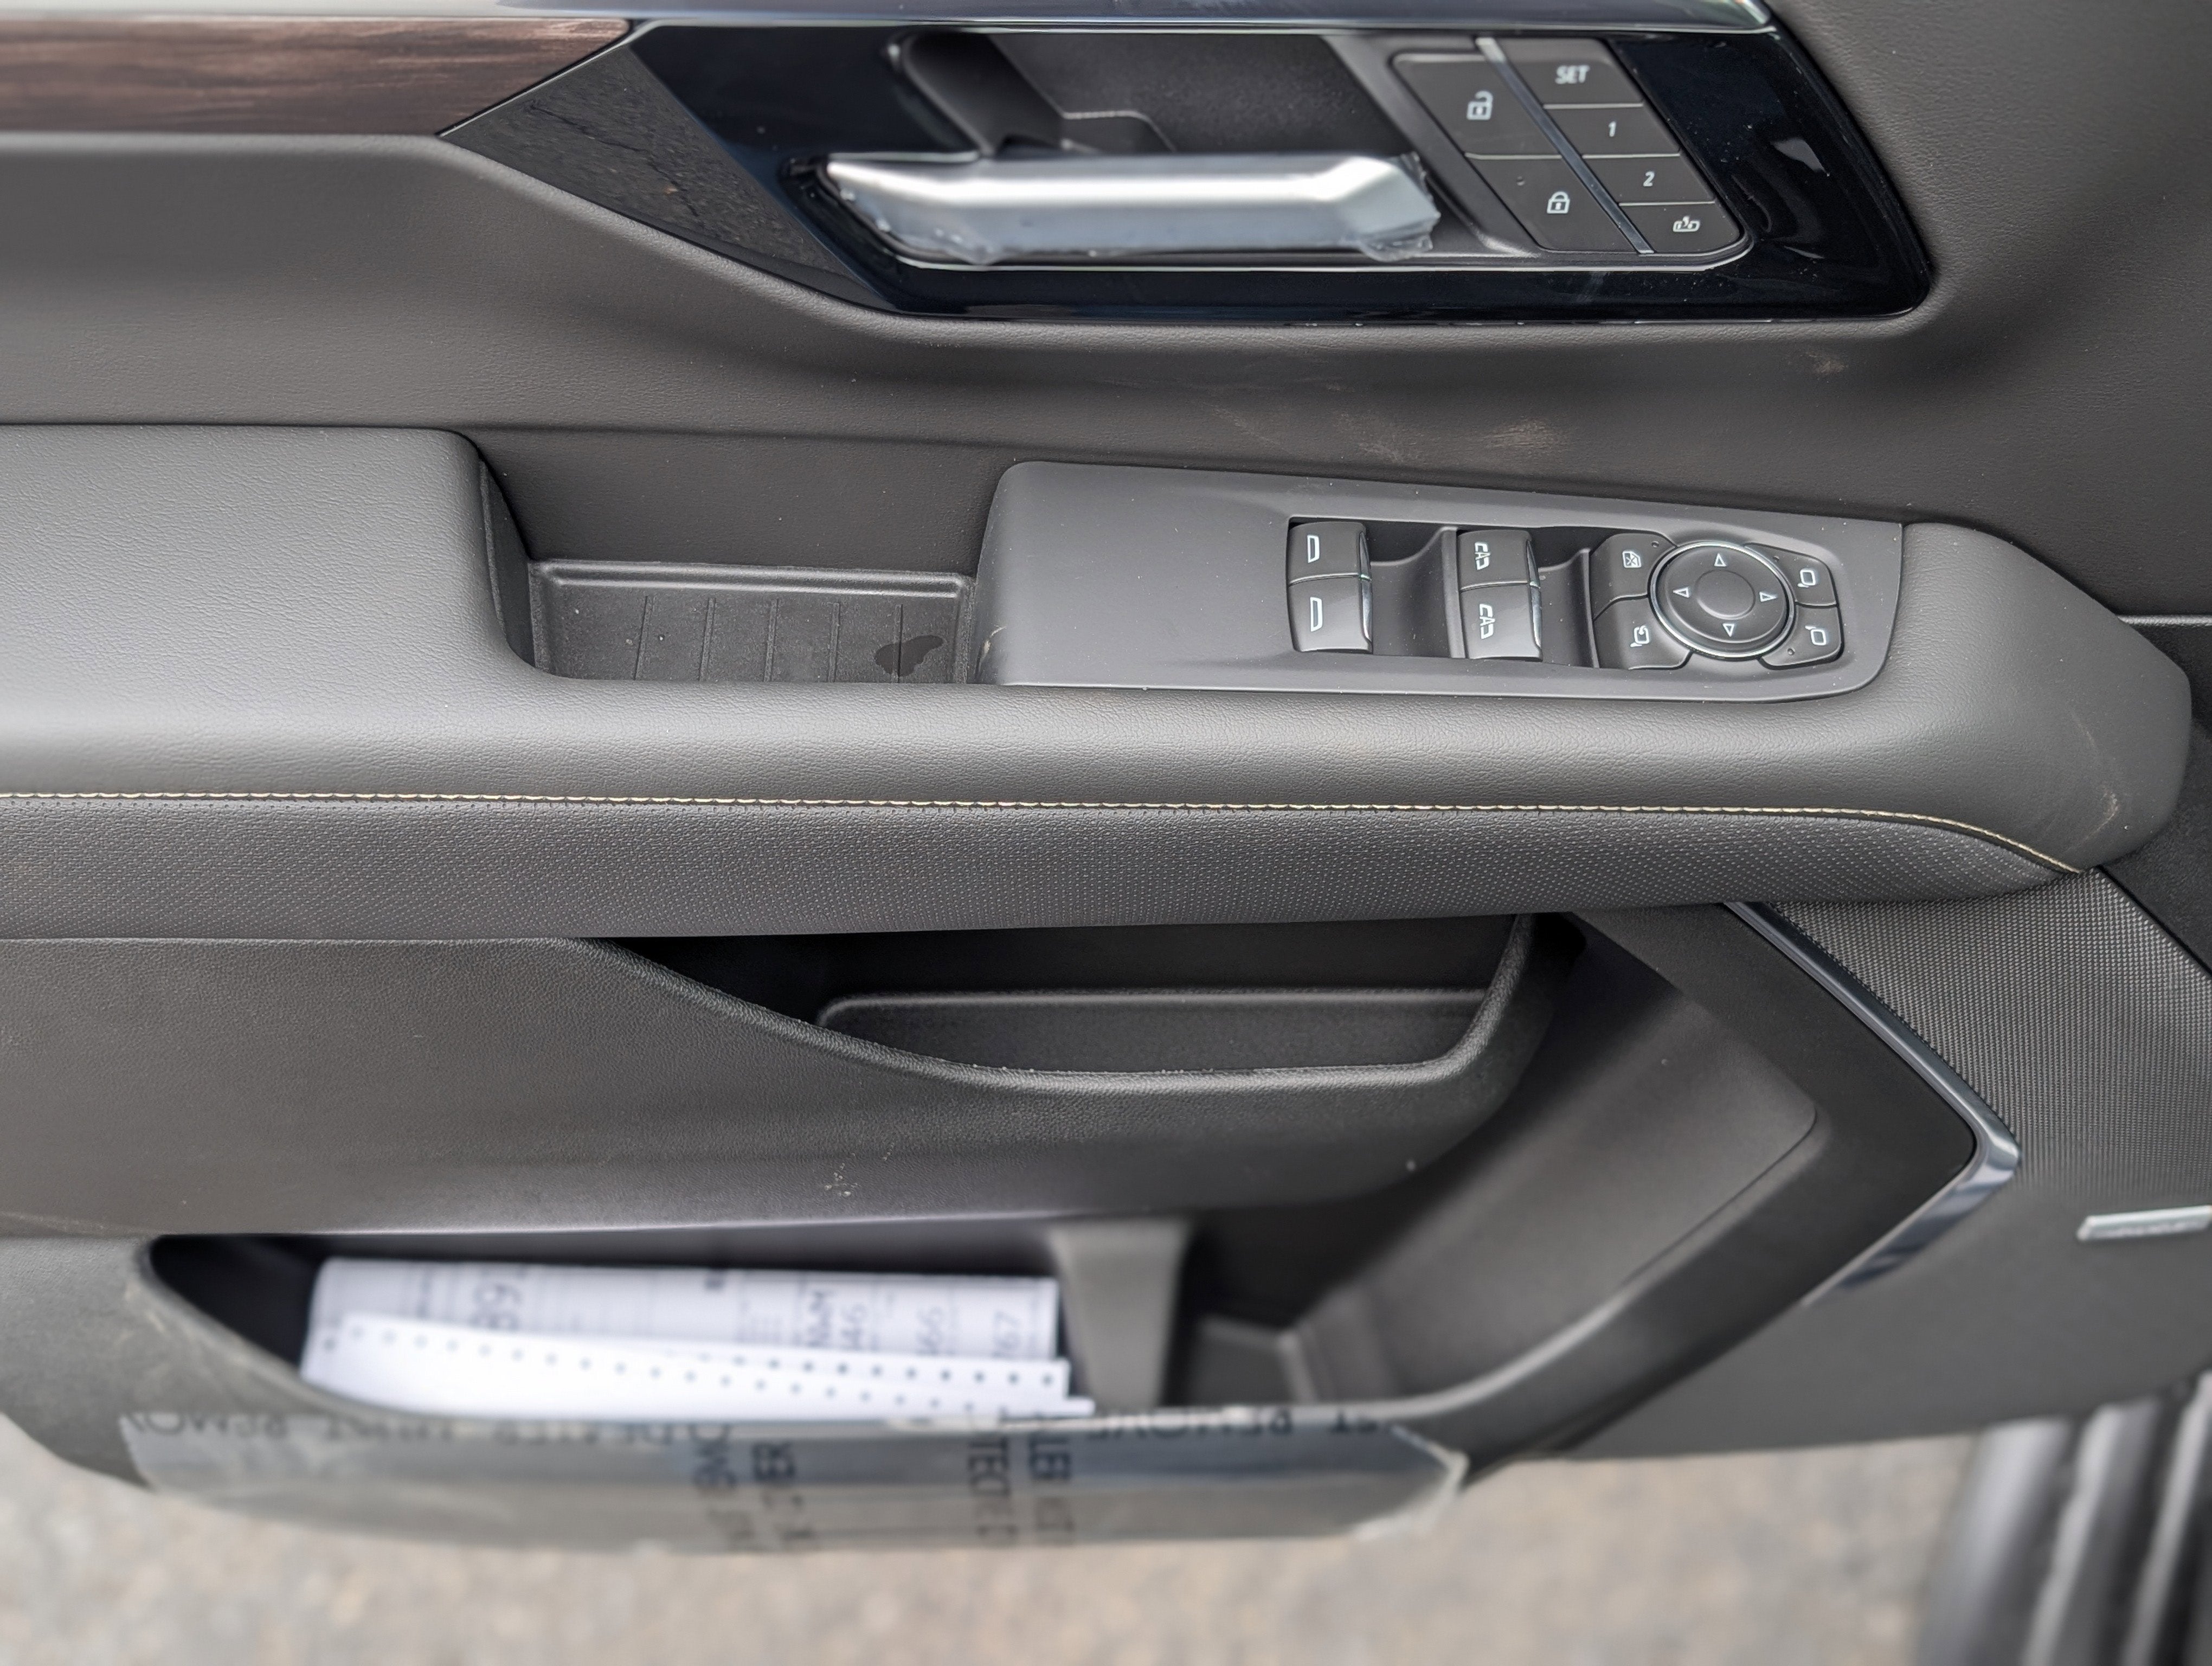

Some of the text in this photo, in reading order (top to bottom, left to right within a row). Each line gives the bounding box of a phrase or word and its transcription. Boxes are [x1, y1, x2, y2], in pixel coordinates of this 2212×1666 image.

[1555, 65, 1590, 85] SET
[1607, 120, 1617, 137] 1
[1642, 171, 1655, 187] 2
